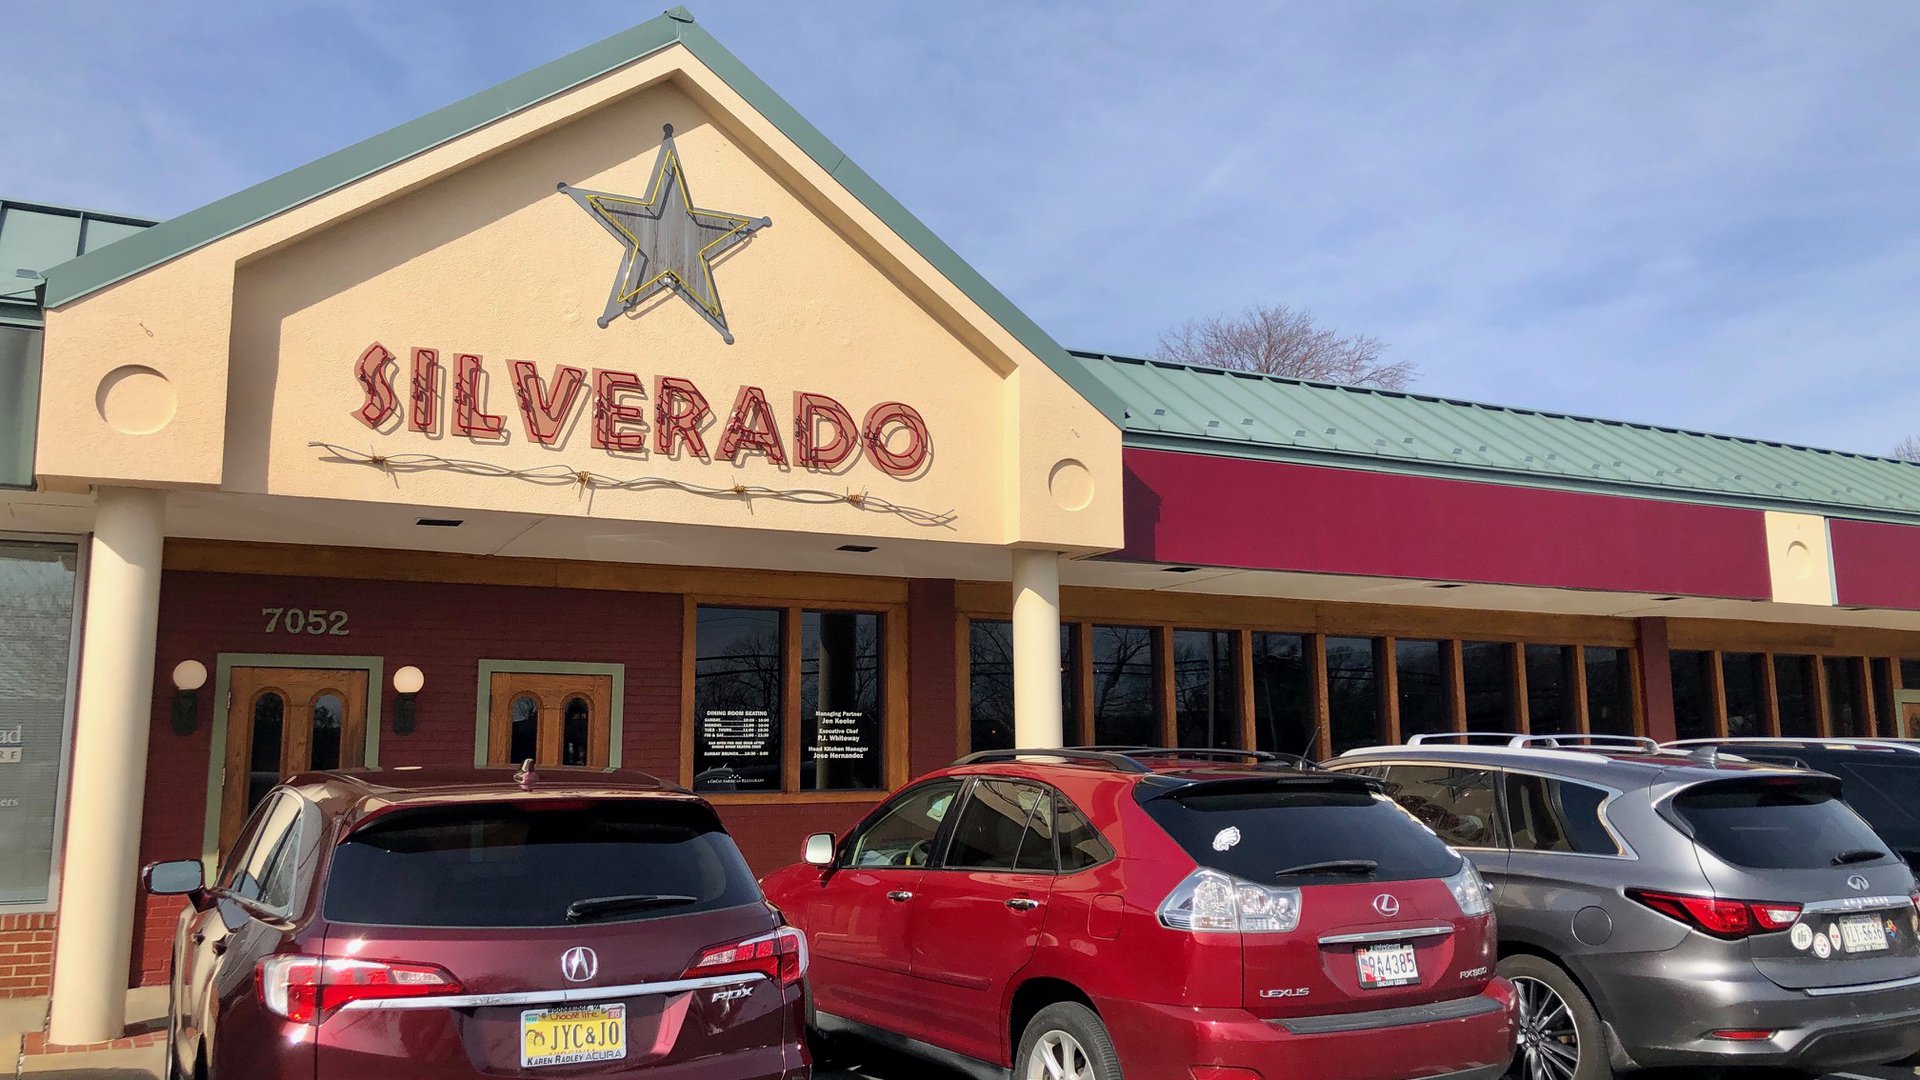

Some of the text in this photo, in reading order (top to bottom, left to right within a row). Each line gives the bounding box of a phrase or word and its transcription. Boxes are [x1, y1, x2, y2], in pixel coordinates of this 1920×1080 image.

[352, 341, 928, 476] SILVERADO
[262, 608, 350, 635] 7052
[1260, 987, 1309, 998] LEXUS
[550, 1021, 620, 1050] JYC&JO
[527, 1050, 622, 1066] KAREN RADLEY ACURA
